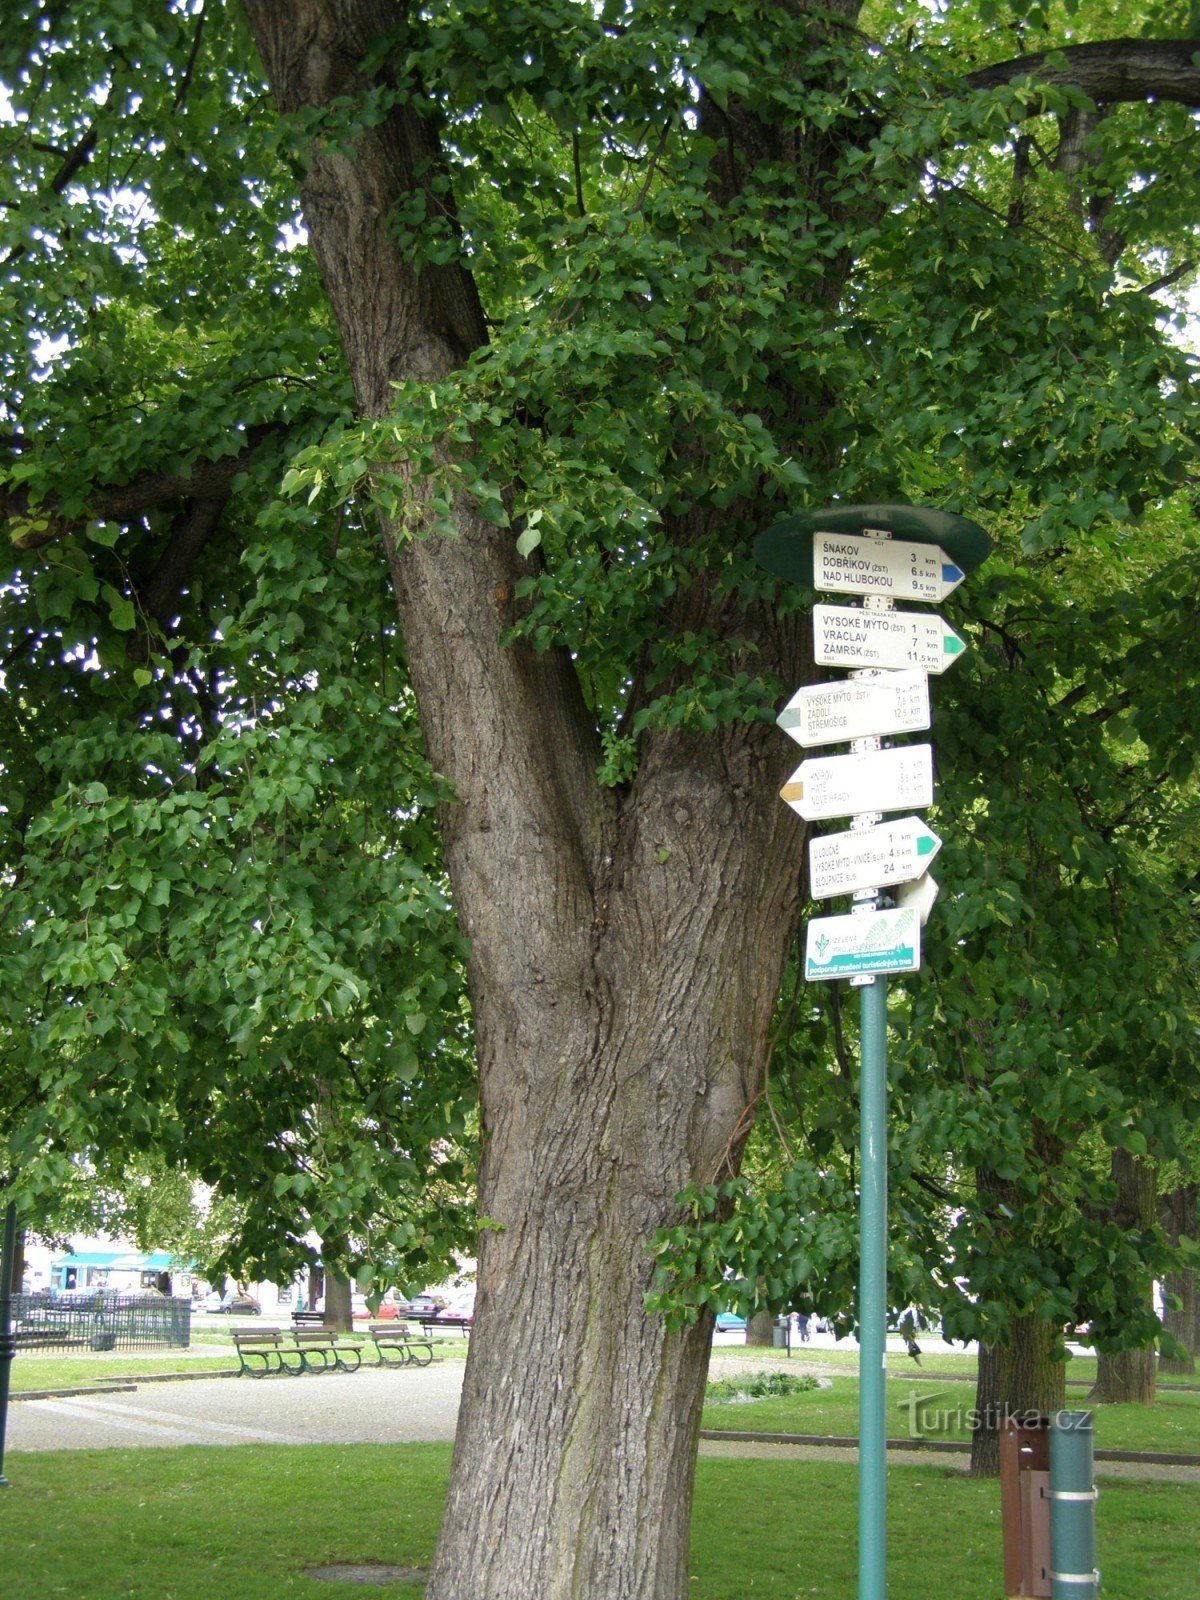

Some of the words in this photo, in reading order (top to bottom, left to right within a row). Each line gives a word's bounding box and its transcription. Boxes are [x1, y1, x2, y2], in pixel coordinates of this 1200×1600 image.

[823, 541, 859, 556] ŠNAKOV
[911, 553, 917, 563] 3
[823, 556, 871, 571] DOBŘÍKOV
[872, 563, 888, 573] (ŽST)
[925, 571, 936, 579] km
[823, 571, 841, 582] NAD
[844, 574, 893, 587] HLUBOKOU
[823, 615, 860, 629] VYSOKÉ
[863, 618, 889, 631] MÝTO
[890, 624, 906, 633] (ŽST)
[911, 624, 917, 633] 1
[823, 630, 867, 642] VRACLAV
[912, 638, 918, 647] 7
[823, 643, 863, 657] ZÁMRSK
[864, 649, 879, 658] (ŽST)
[927, 655, 939, 663] km
[911, 707, 921, 716] km
[888, 833, 893, 842] 1
[884, 863, 894, 874] 24
